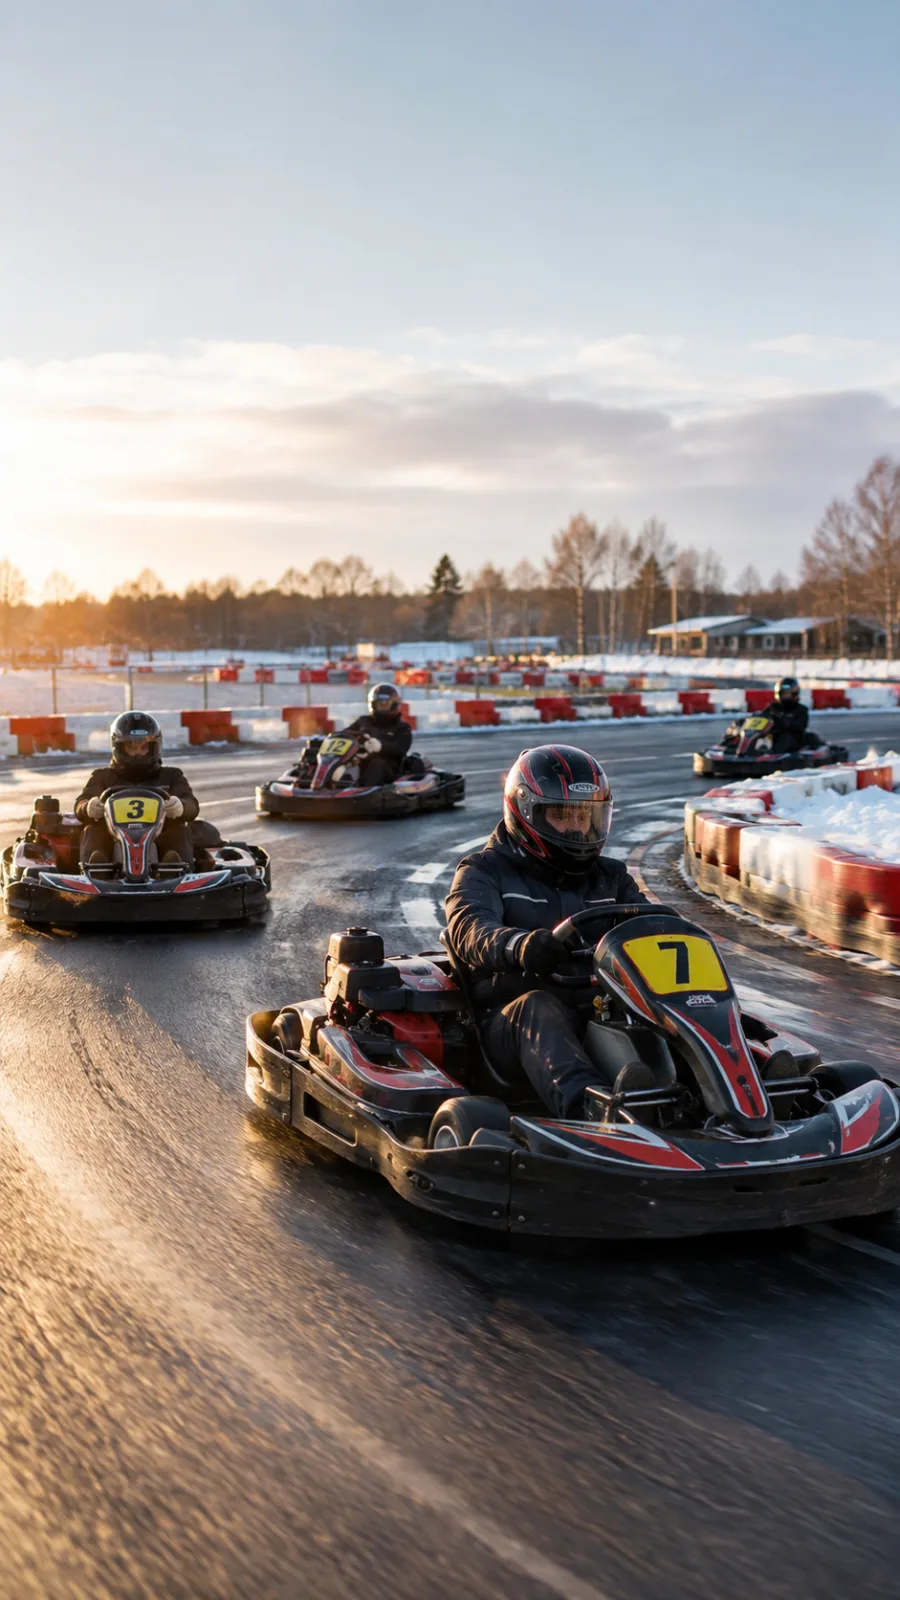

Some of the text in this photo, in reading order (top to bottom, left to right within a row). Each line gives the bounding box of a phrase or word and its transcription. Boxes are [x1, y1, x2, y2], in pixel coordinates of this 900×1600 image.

[326, 740, 346, 753] 12
[126, 800, 145, 819] 3
[657, 941, 690, 985] 7
